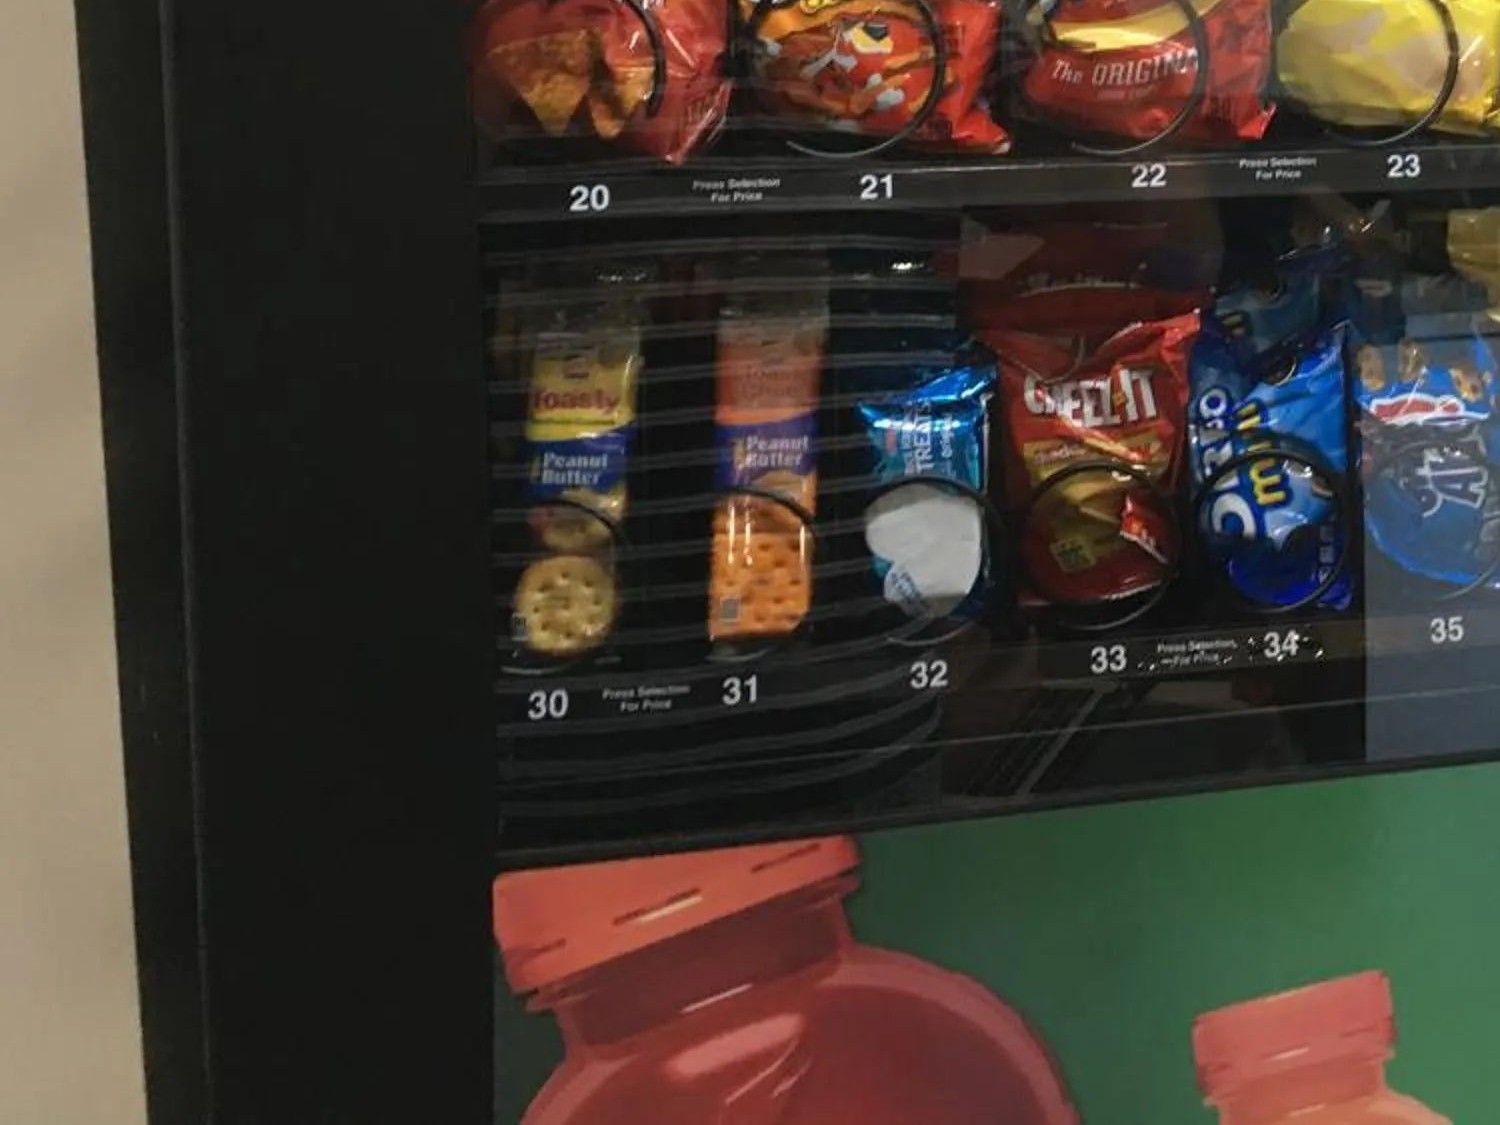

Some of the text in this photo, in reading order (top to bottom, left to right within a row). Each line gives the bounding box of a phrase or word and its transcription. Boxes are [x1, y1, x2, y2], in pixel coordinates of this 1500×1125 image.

[1051, 46, 1200, 87] The ORIGINA
[1131, 162, 1168, 188] 22
[1386, 153, 1422, 178] 23
[727, 177, 781, 189] Selection
[858, 173, 895, 200] 21
[569, 184, 611, 212] 20
[745, 434, 810, 452] Peanut
[543, 451, 609, 469] Peanut
[745, 451, 804, 469] Butter
[541, 468, 603, 486] Butter
[1430, 616, 1464, 644] 35
[1263, 629, 1300, 659] 34
[1090, 644, 1128, 674] 33
[910, 660, 949, 689] 32
[722, 674, 759, 705] 31
[527, 689, 569, 720] 30
